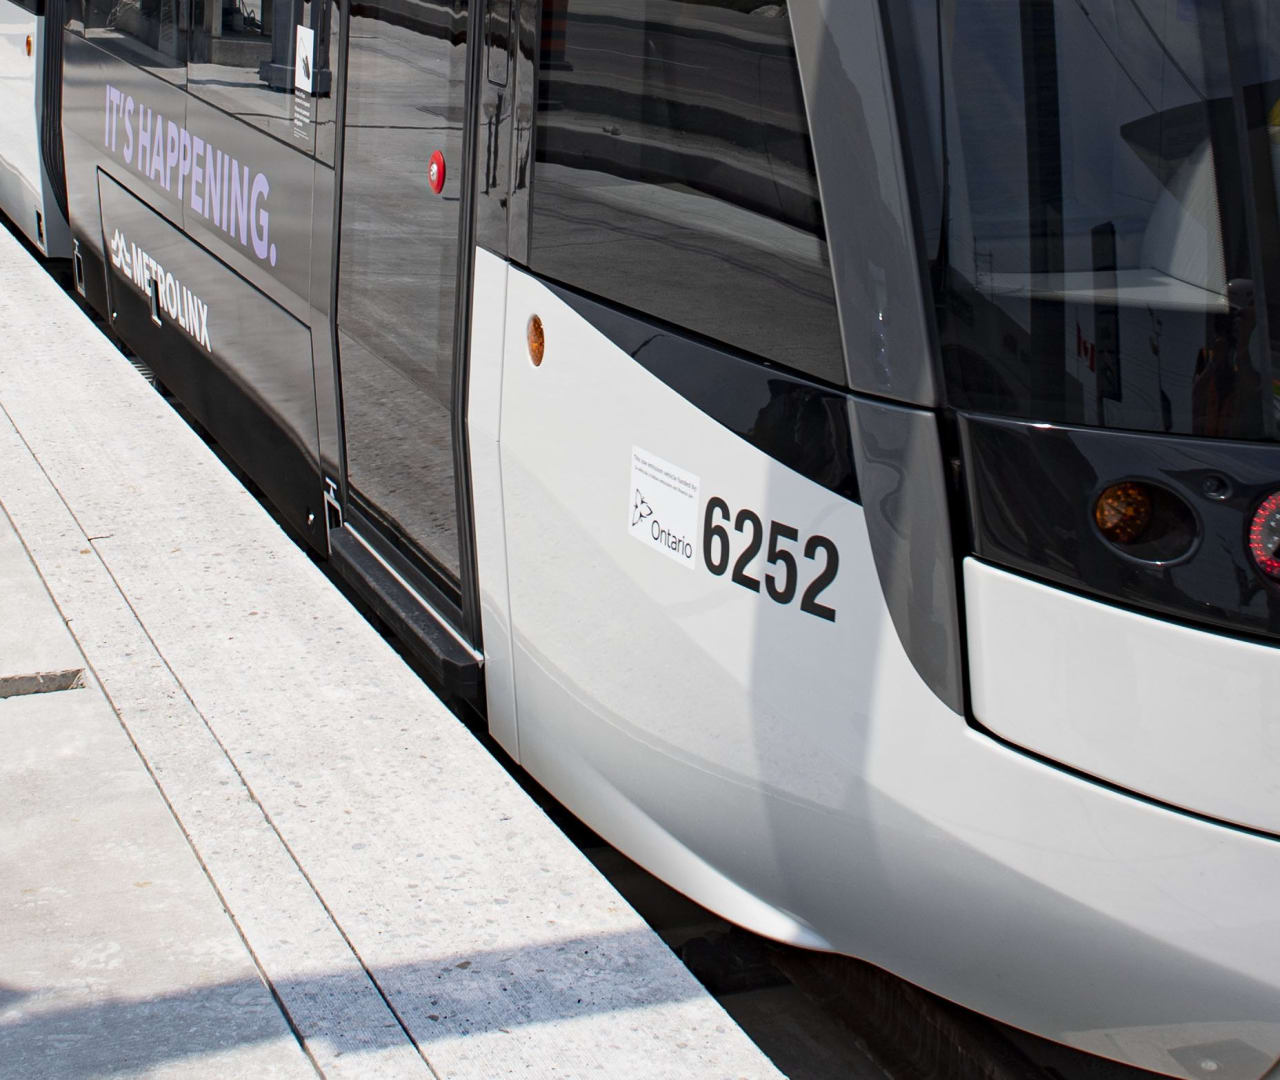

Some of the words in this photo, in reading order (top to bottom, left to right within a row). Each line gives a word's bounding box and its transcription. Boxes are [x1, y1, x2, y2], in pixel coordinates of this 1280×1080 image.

[104, 84, 135, 165] IT'S
[137, 103, 277, 267] HAPPENING.
[131, 242, 212, 353] METROLINX
[651, 519, 693, 559] Ontario
[703, 496, 840, 623] 6252
